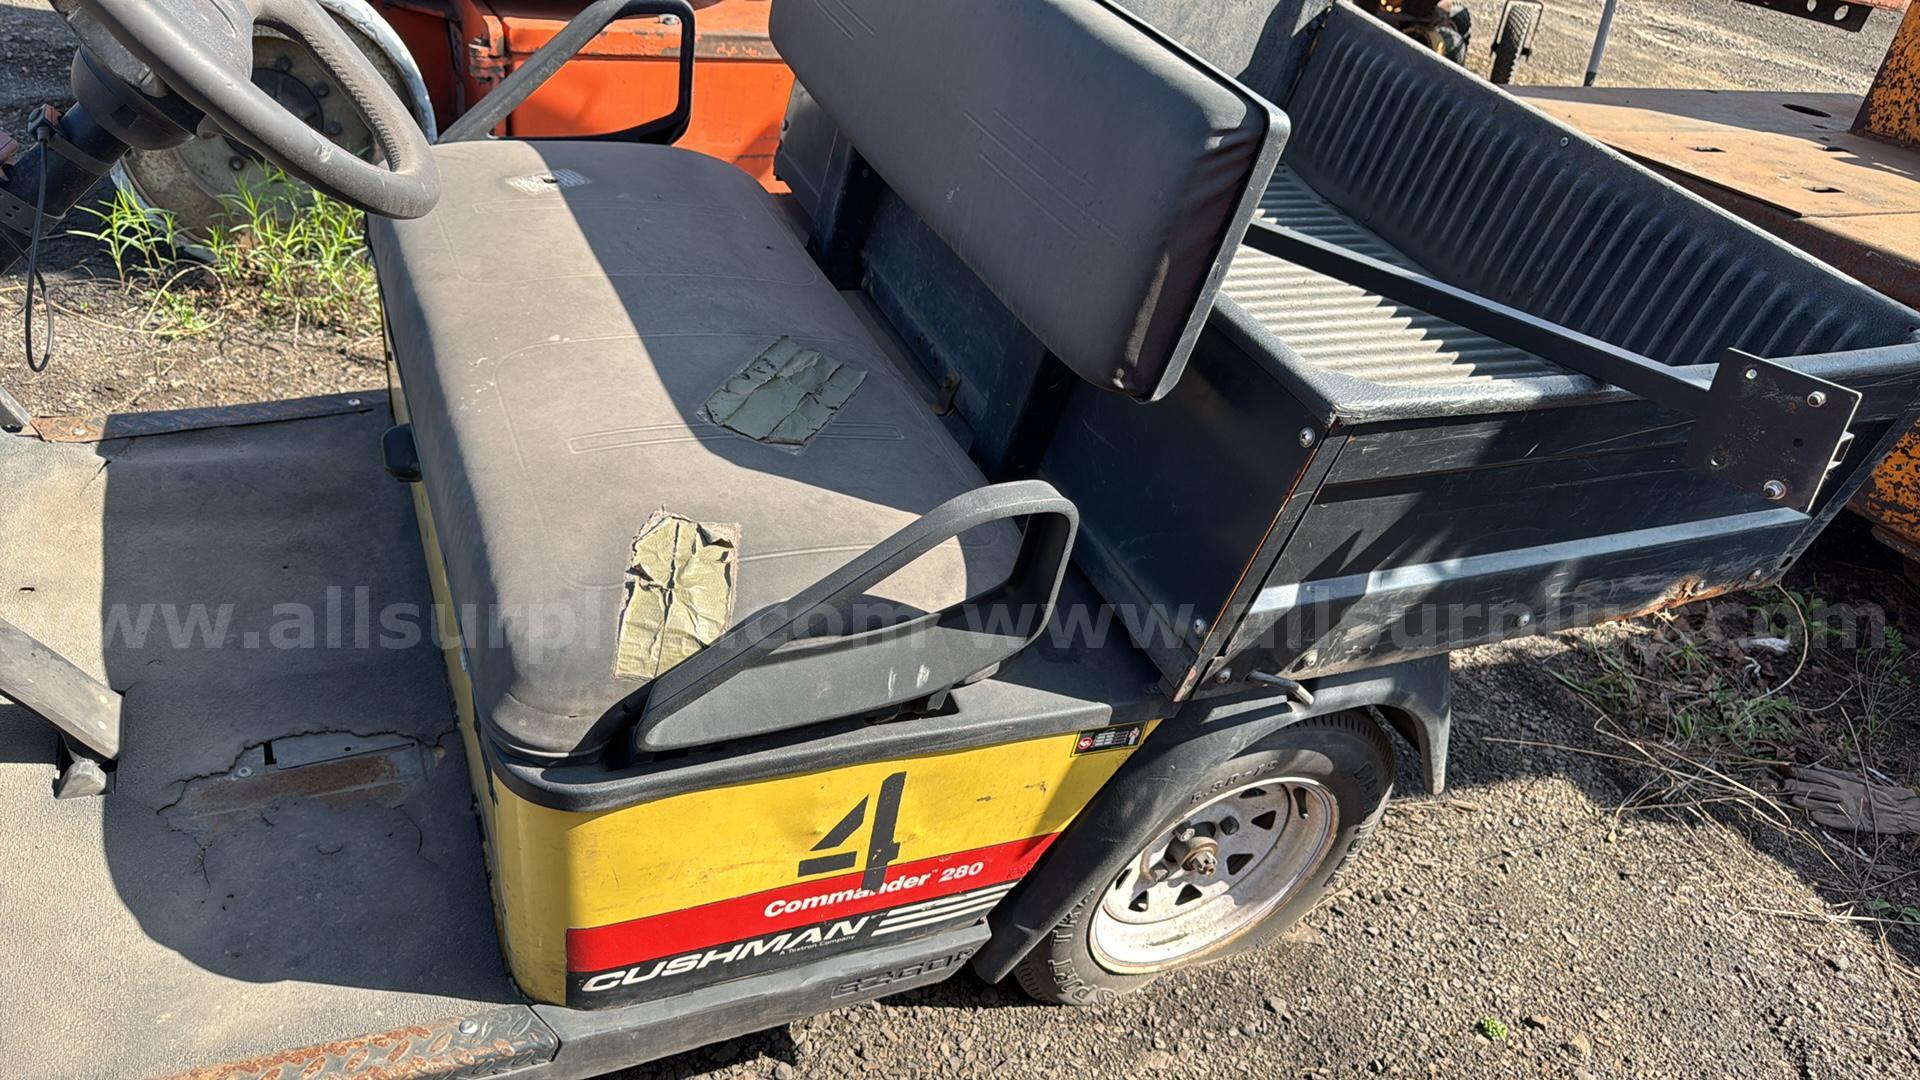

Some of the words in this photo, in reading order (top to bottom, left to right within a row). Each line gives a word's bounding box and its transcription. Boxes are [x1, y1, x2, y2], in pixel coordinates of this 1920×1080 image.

[797, 770, 907, 893] 4
[938, 862, 984, 882] 280
[582, 916, 869, 992] CUSHMAN
[788, 943, 818, 954] Textron
[819, 935, 856, 947] Company
